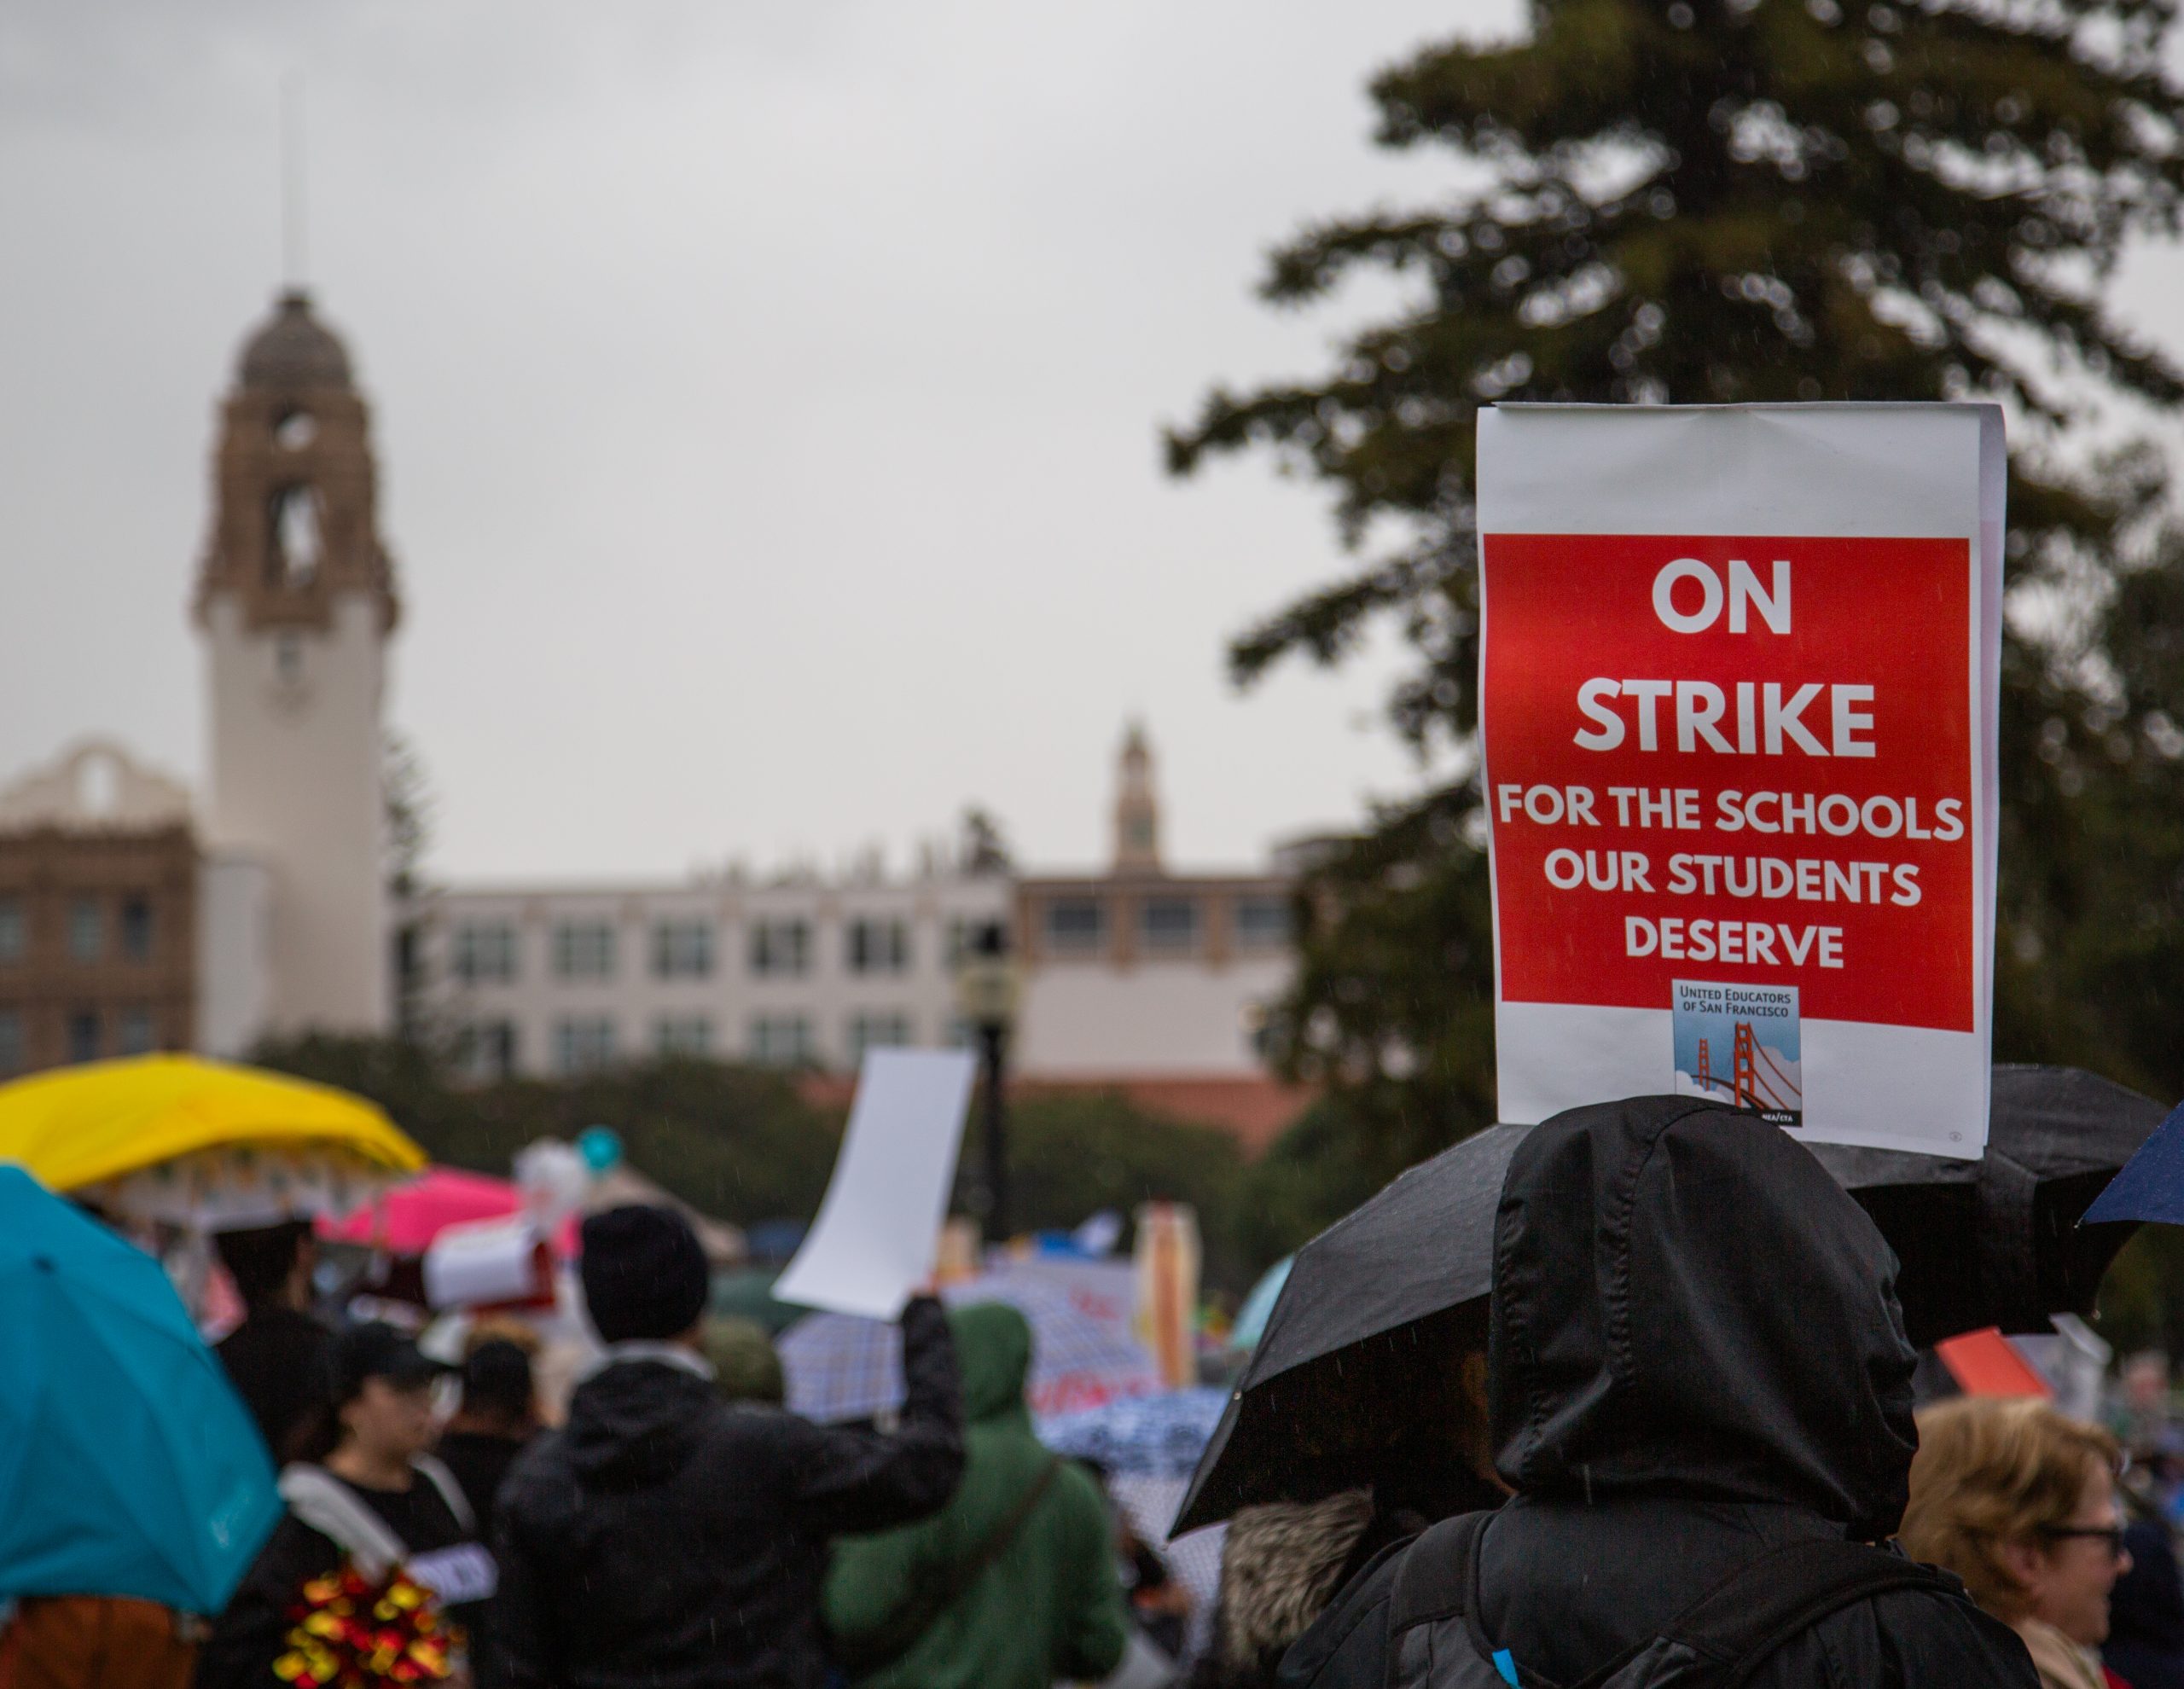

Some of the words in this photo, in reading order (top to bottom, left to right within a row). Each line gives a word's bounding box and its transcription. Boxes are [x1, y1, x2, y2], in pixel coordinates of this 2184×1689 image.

[1652, 558, 1792, 635] ON
[1572, 676, 1876, 757] STRIKE
[1497, 784, 1600, 826] FOR
[1607, 786, 1701, 831] THE
[1715, 789, 1965, 841] SCHOOLS
[1543, 848, 1656, 893] OUR
[1667, 853, 1922, 907] STUDENTS
[1624, 915, 1844, 969] DESERVE
[1680, 985, 1722, 1000] UNITED
[1725, 989, 1792, 1004] EDUCATORS
[1683, 1001, 1698, 1012] OF
[1699, 1001, 1722, 1013] SAN
[1726, 1003, 1789, 1018] FRANCISCO
